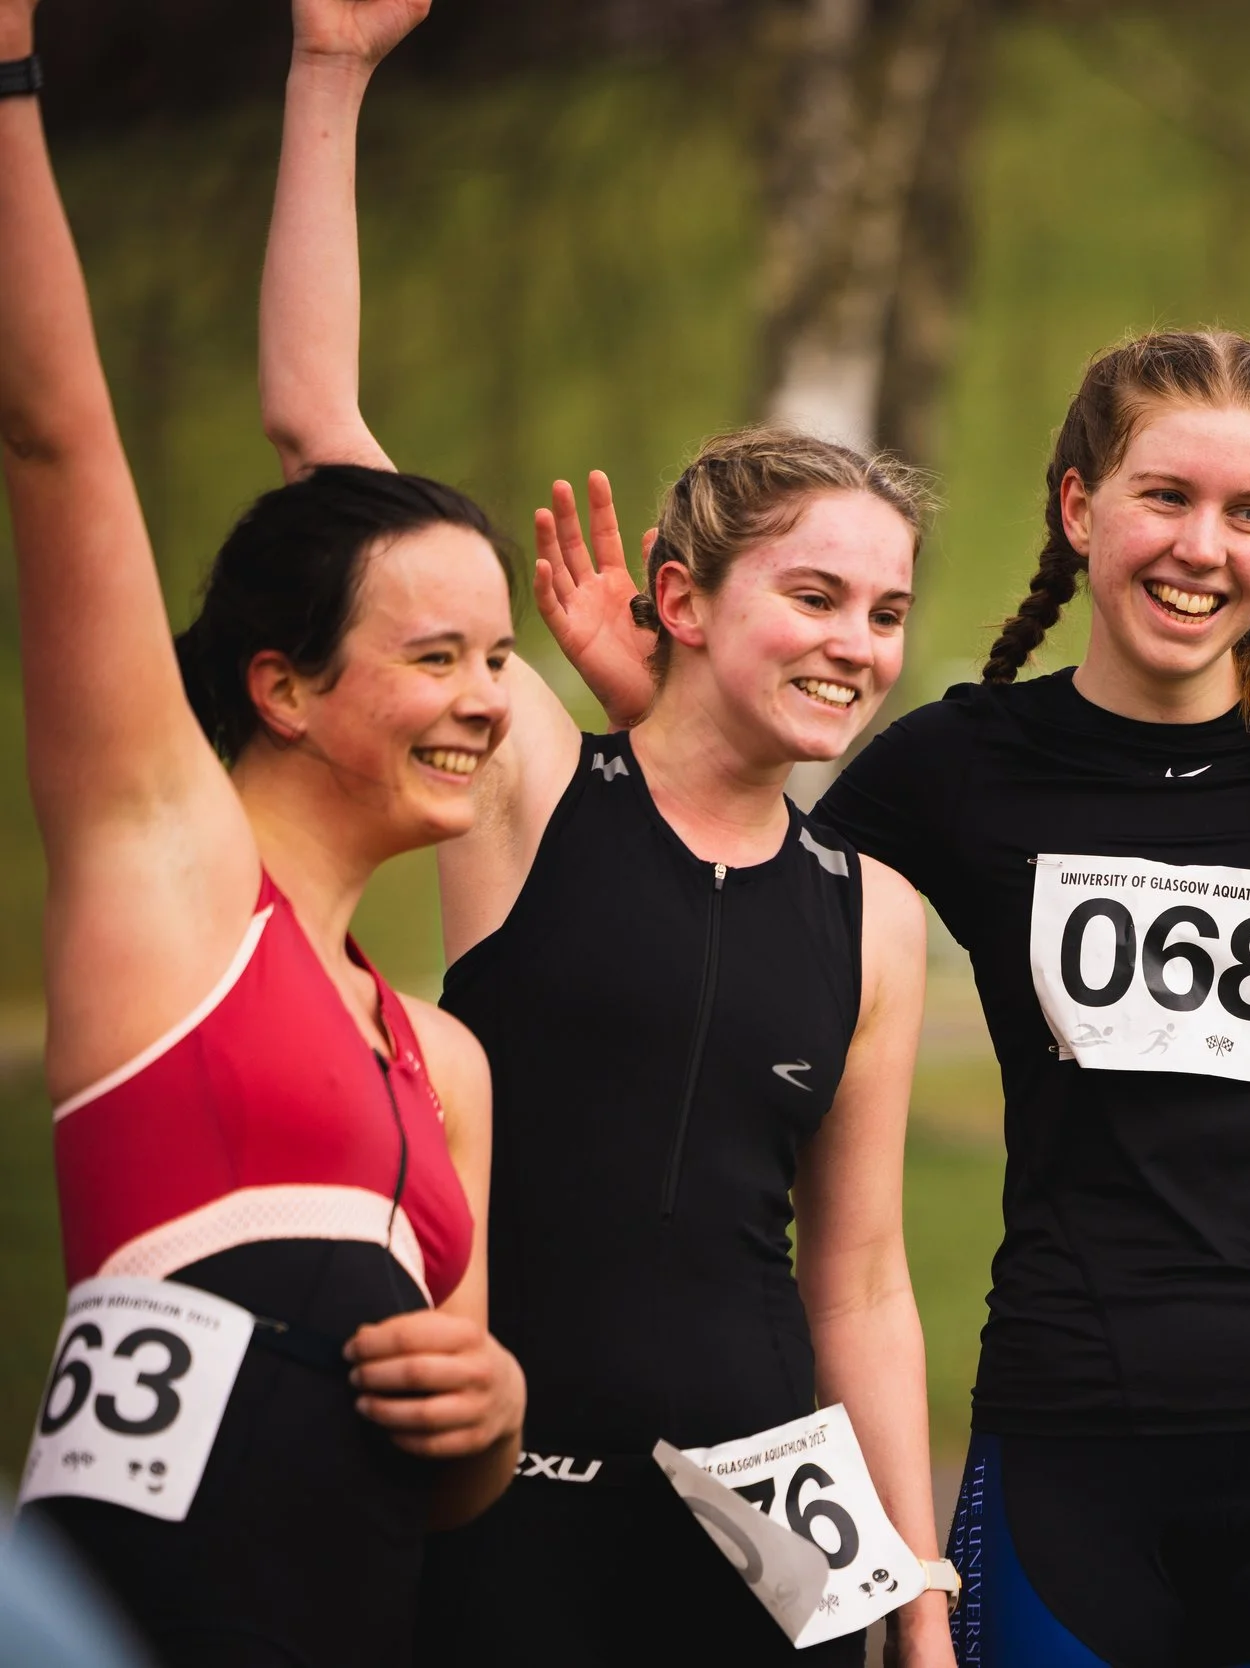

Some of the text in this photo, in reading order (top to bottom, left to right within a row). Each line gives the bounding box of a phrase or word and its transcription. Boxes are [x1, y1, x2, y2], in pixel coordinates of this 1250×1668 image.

[1061, 872, 1128, 888] UNIVERSITY
[1131, 876, 1147, 889] OF
[1150, 877, 1210, 896] GLASGOW
[40, 1322, 193, 1438] 63
[716, 1453, 762, 1476] GLASGOW
[764, 1436, 808, 1463] AQUATHLON
[965, 1458, 986, 1668] THE UNIVERSI
